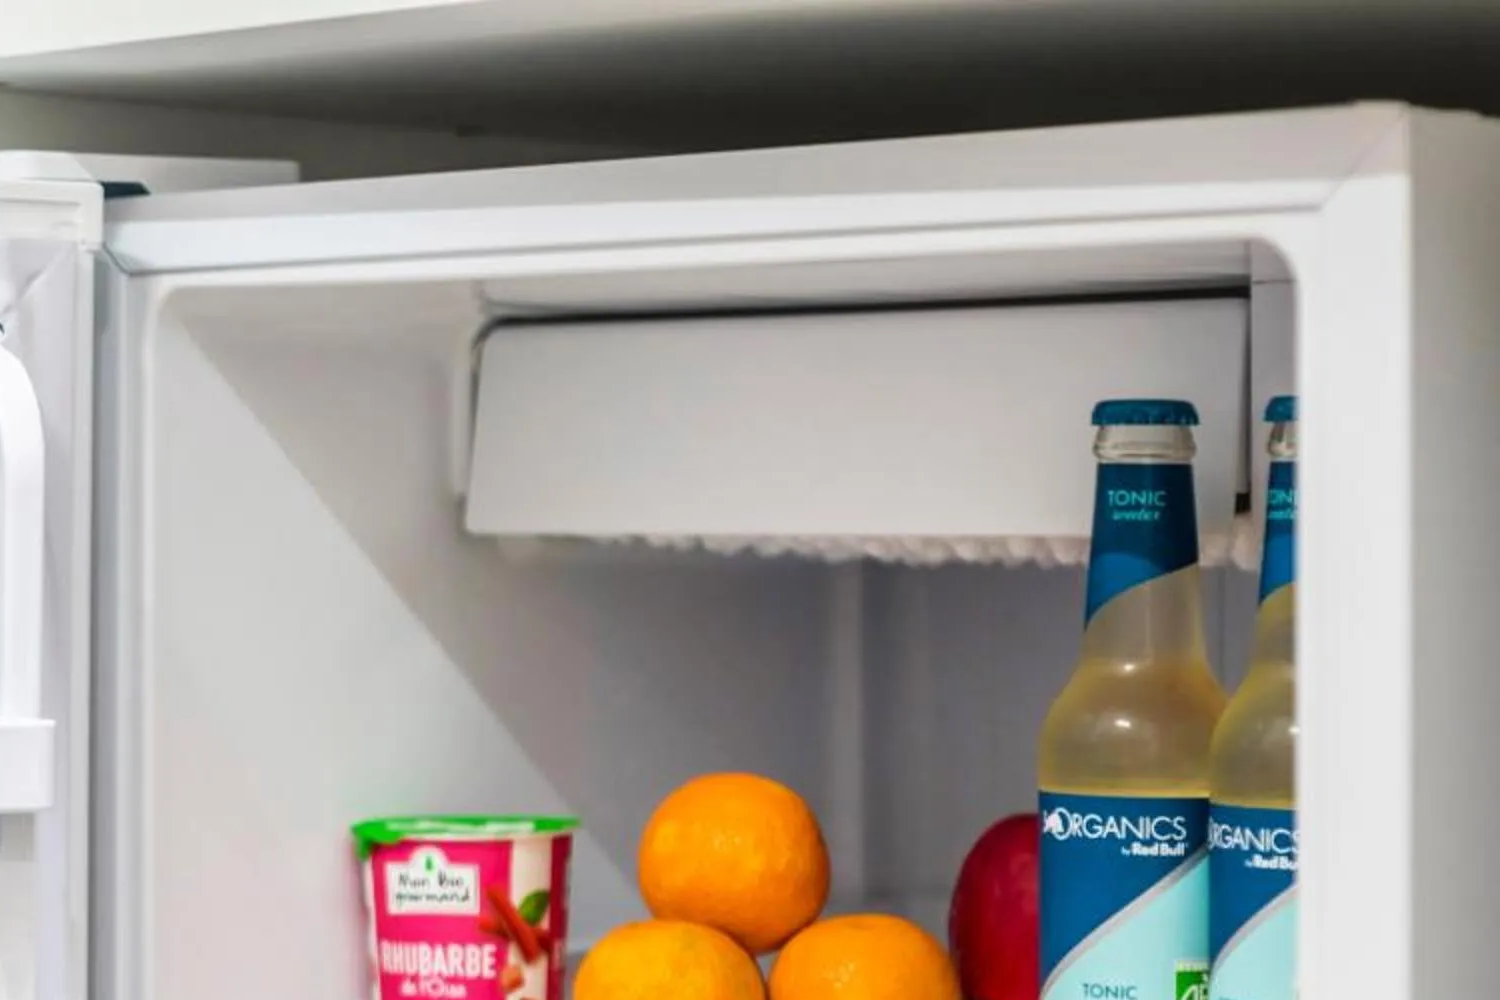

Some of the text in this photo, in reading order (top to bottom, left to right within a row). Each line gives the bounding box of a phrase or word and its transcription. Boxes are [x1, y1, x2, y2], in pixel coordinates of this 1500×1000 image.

[1108, 490, 1167, 506] TONIC
[1049, 806, 1187, 841] ORGANICS
[381, 939, 497, 979] RHUBARBE
[1082, 983, 1139, 1000] TONIC
